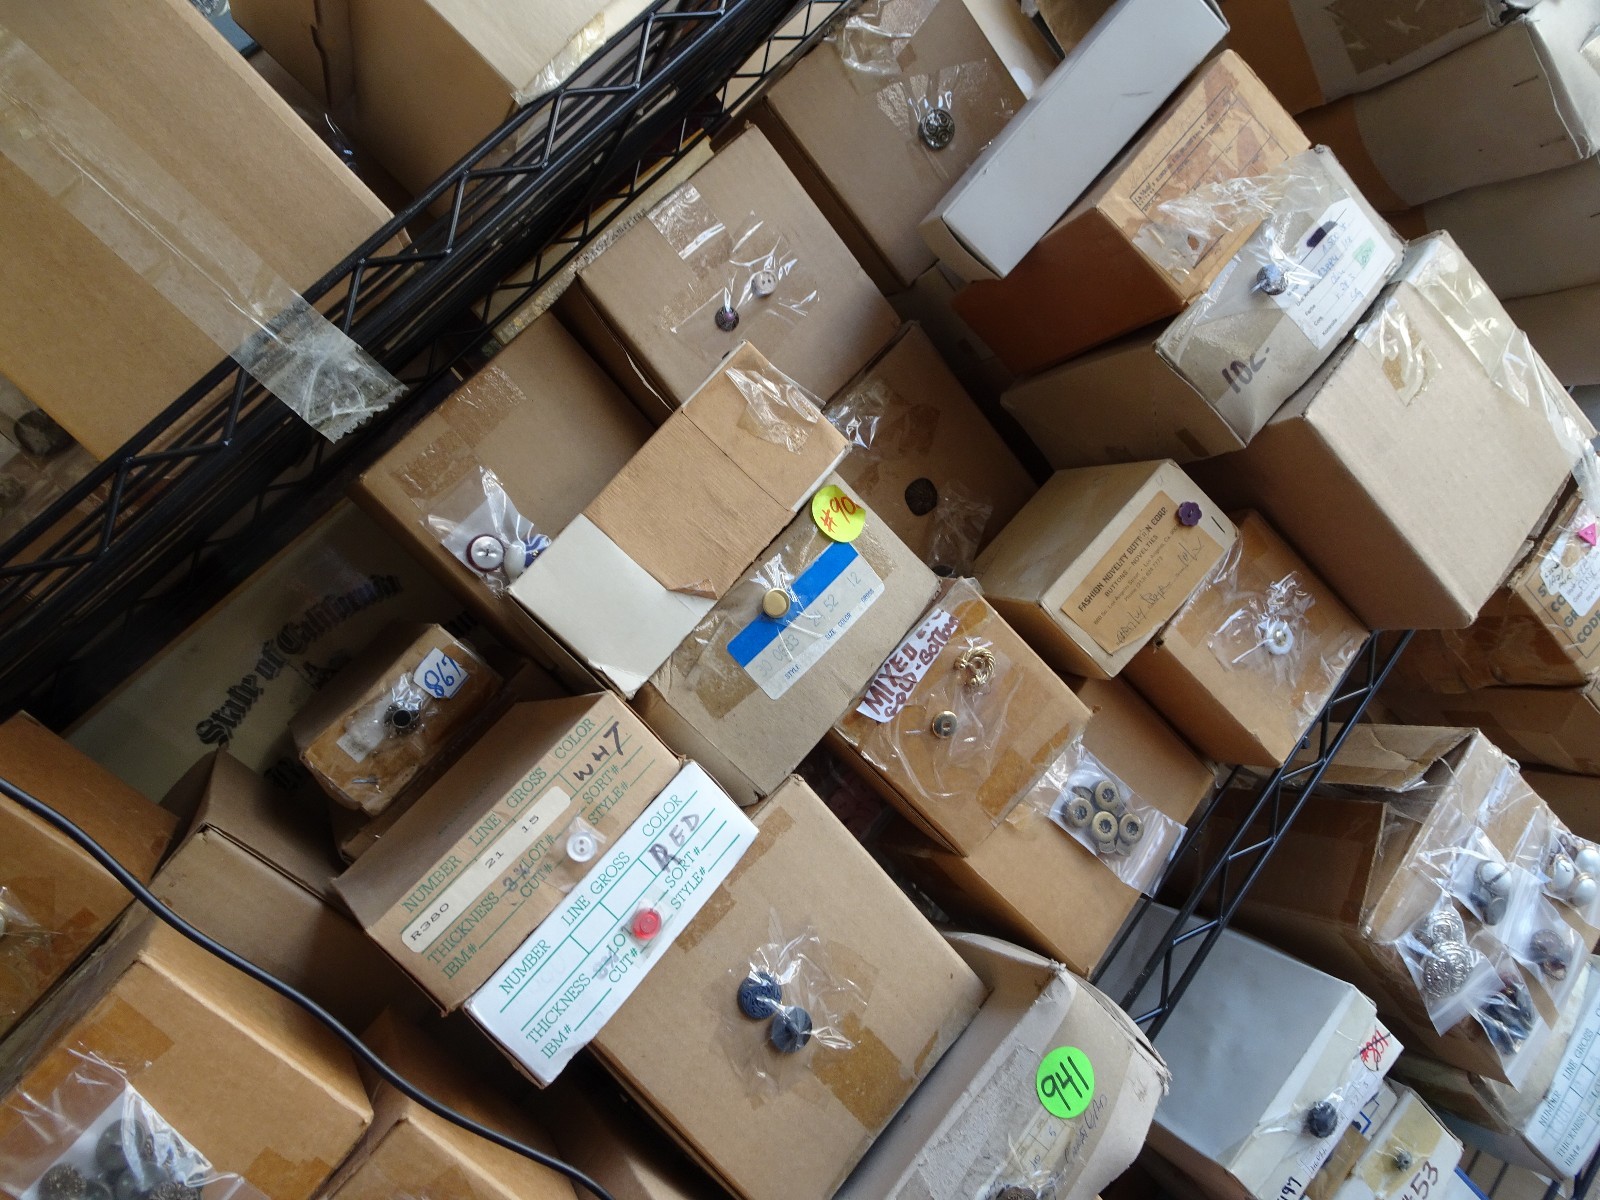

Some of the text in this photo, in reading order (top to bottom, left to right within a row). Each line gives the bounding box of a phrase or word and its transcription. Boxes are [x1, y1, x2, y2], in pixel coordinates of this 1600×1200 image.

[820, 592, 840, 612] 52
[845, 570, 862, 588] 12
[1076, 581, 1105, 612] FASHION
[1100, 552, 1130, 583] NOVELTY
[195, 674, 264, 745] State
[255, 638, 289, 680] of
[276, 573, 403, 655] California
[423, 654, 463, 698] 867
[783, 662, 801, 680] STYLE
[823, 627, 837, 640] SIZE
[836, 611, 853, 627] COLOR
[864, 640, 918, 717] MIXED
[572, 720, 626, 782] WHT
[401, 852, 463, 914] NUMBER
[466, 811, 503, 848] LINE
[502, 764, 549, 810] GROSS
[551, 715, 597, 761] COLOR
[648, 811, 701, 873] RED
[408, 812, 541, 943] R380 21 15
[425, 889, 502, 966] THICKNESS
[519, 831, 558, 870] LOT#
[580, 762, 623, 806] SORT#
[440, 778, 632, 980] IBM# CUT# STYLE#
[497, 792, 684, 995] NUMBER LINE GROSS COLOR
[523, 971, 594, 1046] THICKNESS
[661, 844, 705, 889] SORT#
[539, 865, 711, 1059] IBM# CUT# STYLE#
[1041, 1056, 1089, 1111] 941
[1559, 1058, 1579, 1081] LINE
